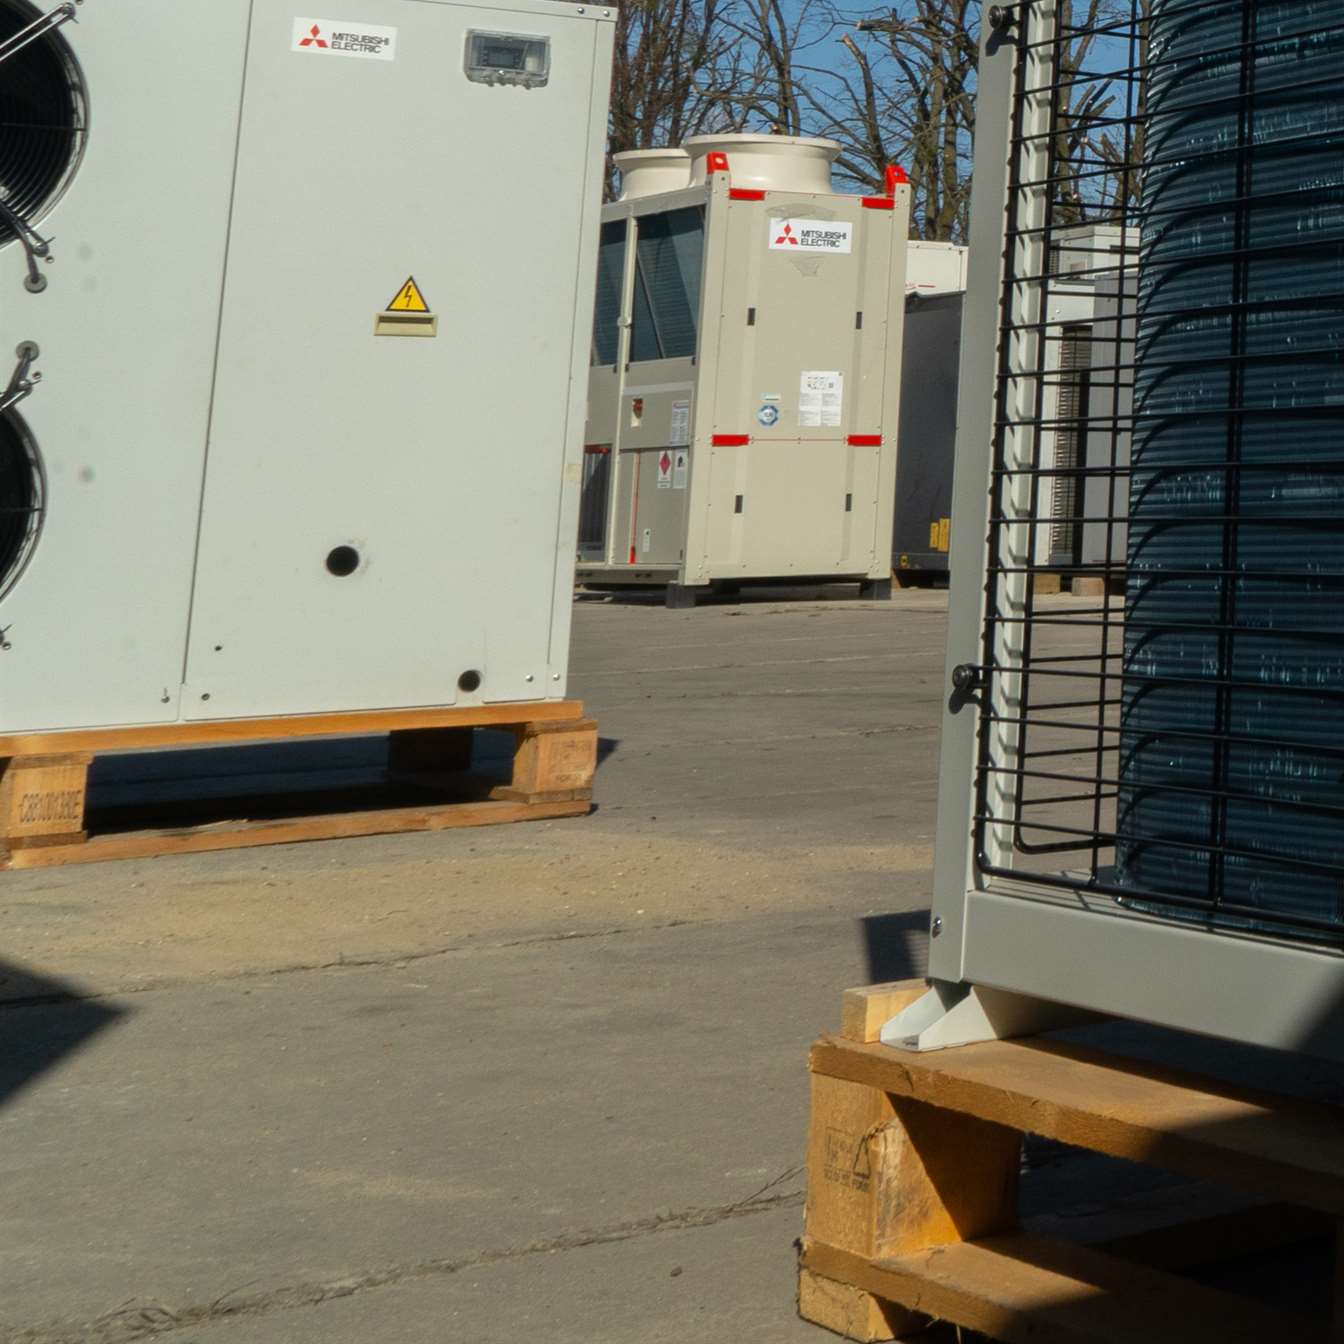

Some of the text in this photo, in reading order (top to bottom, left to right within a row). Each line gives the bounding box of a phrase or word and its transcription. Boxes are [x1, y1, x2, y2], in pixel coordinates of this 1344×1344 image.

[332, 32, 390, 46] MITSUBISHI
[331, 41, 382, 54] ELECTRIC
[800, 229, 847, 240] MITSUBISHI
[800, 238, 841, 248] ELECTRIC
